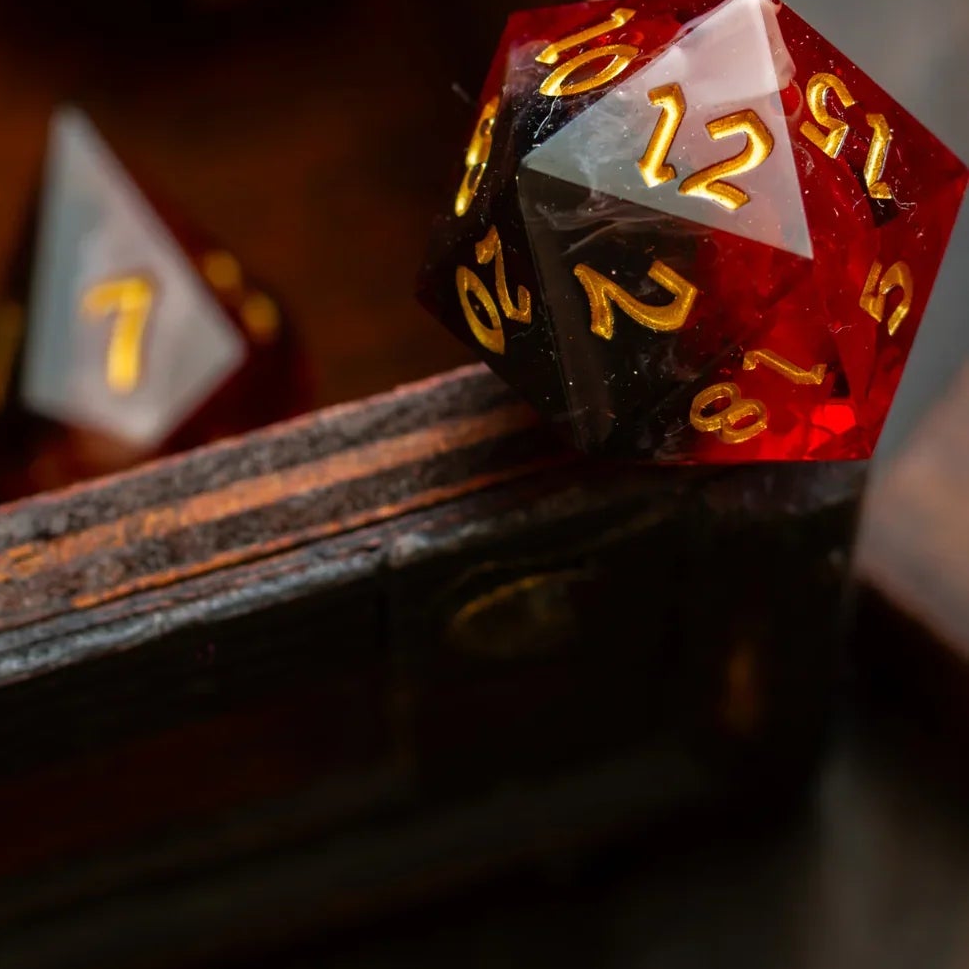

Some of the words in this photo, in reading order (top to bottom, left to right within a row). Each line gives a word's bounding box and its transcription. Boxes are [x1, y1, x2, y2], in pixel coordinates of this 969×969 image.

[534, 7, 640, 97] 10
[637, 82, 775, 211] 12
[798, 72, 893, 200] 15
[455, 223, 531, 356] 20
[572, 259, 698, 341] 2
[859, 259, 914, 336] 5
[688, 348, 828, 444] 18
